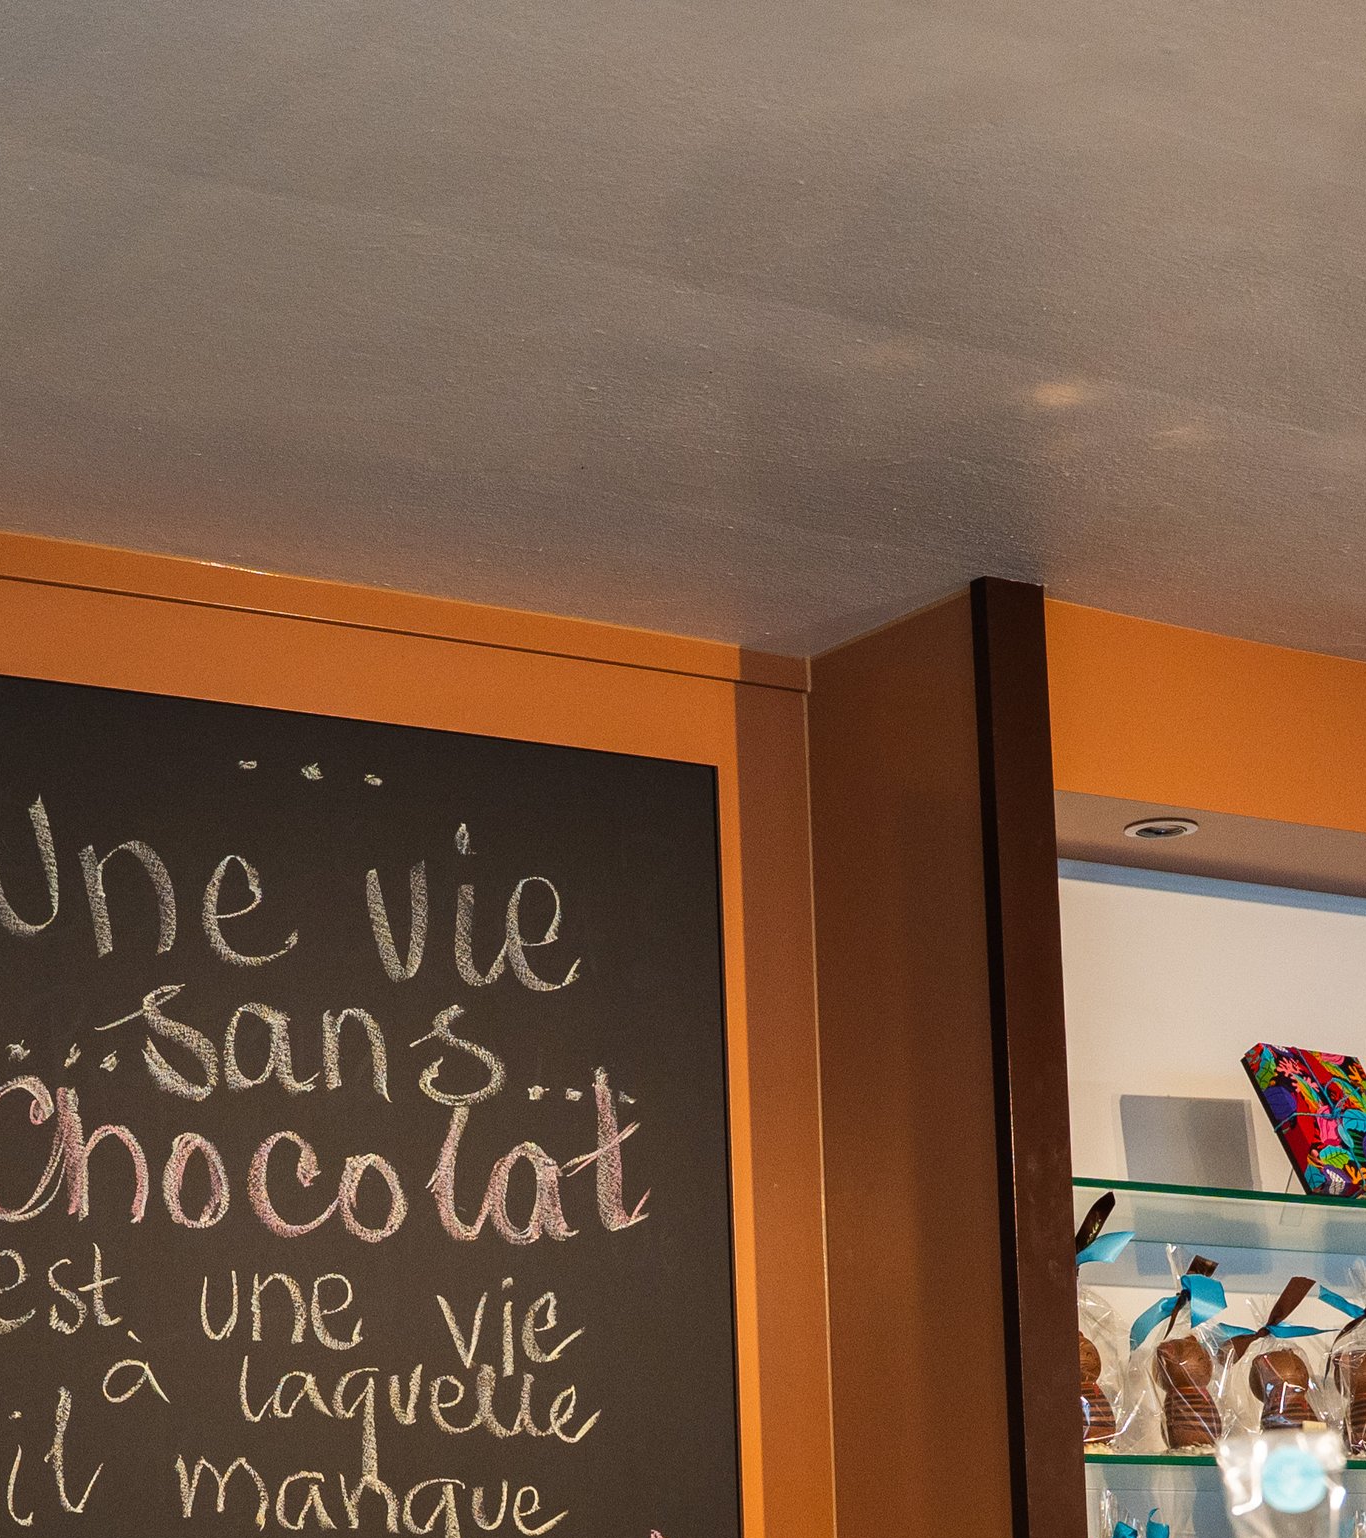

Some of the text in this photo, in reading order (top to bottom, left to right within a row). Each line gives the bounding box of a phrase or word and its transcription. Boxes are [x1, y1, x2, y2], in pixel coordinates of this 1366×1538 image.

[366, 823, 581, 992] vie
[96, 983, 505, 1106] sans
[199, 1270, 363, 1349] une
[437, 1278, 585, 1377] vie
[7, 1386, 103, 1527] il
[102, 1331, 601, 1478] à laquelle
